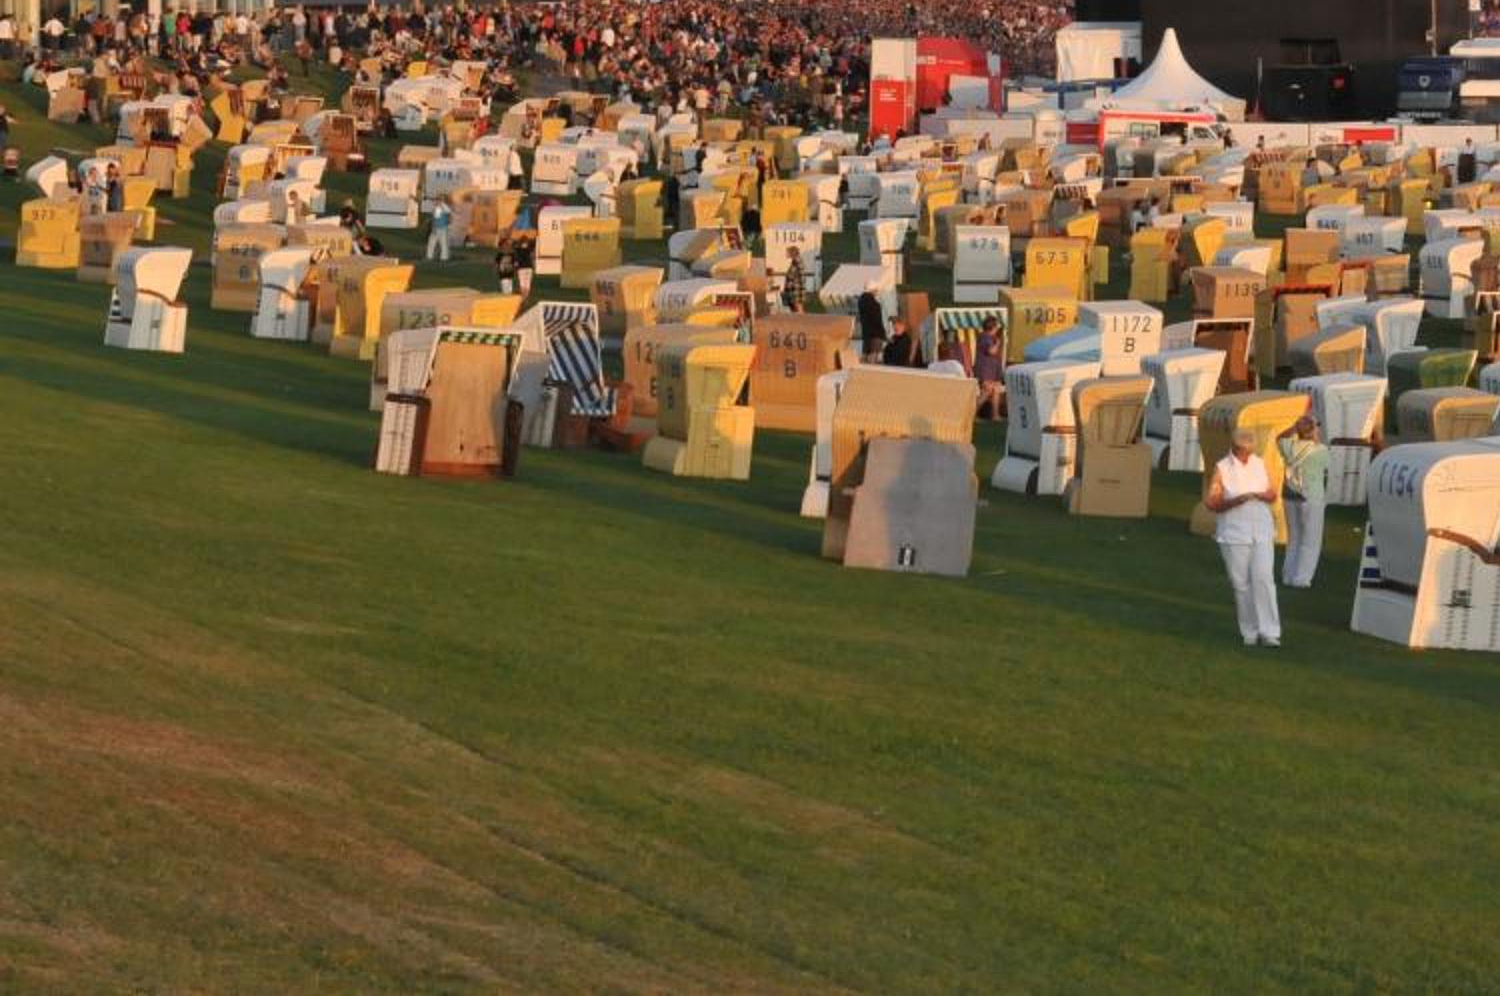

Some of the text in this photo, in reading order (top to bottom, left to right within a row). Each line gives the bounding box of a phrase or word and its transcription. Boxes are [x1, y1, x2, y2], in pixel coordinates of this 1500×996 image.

[1112, 316, 1151, 333] 1172
[768, 331, 807, 350] 640
[1124, 337, 1135, 353] B
[784, 360, 796, 377] B
